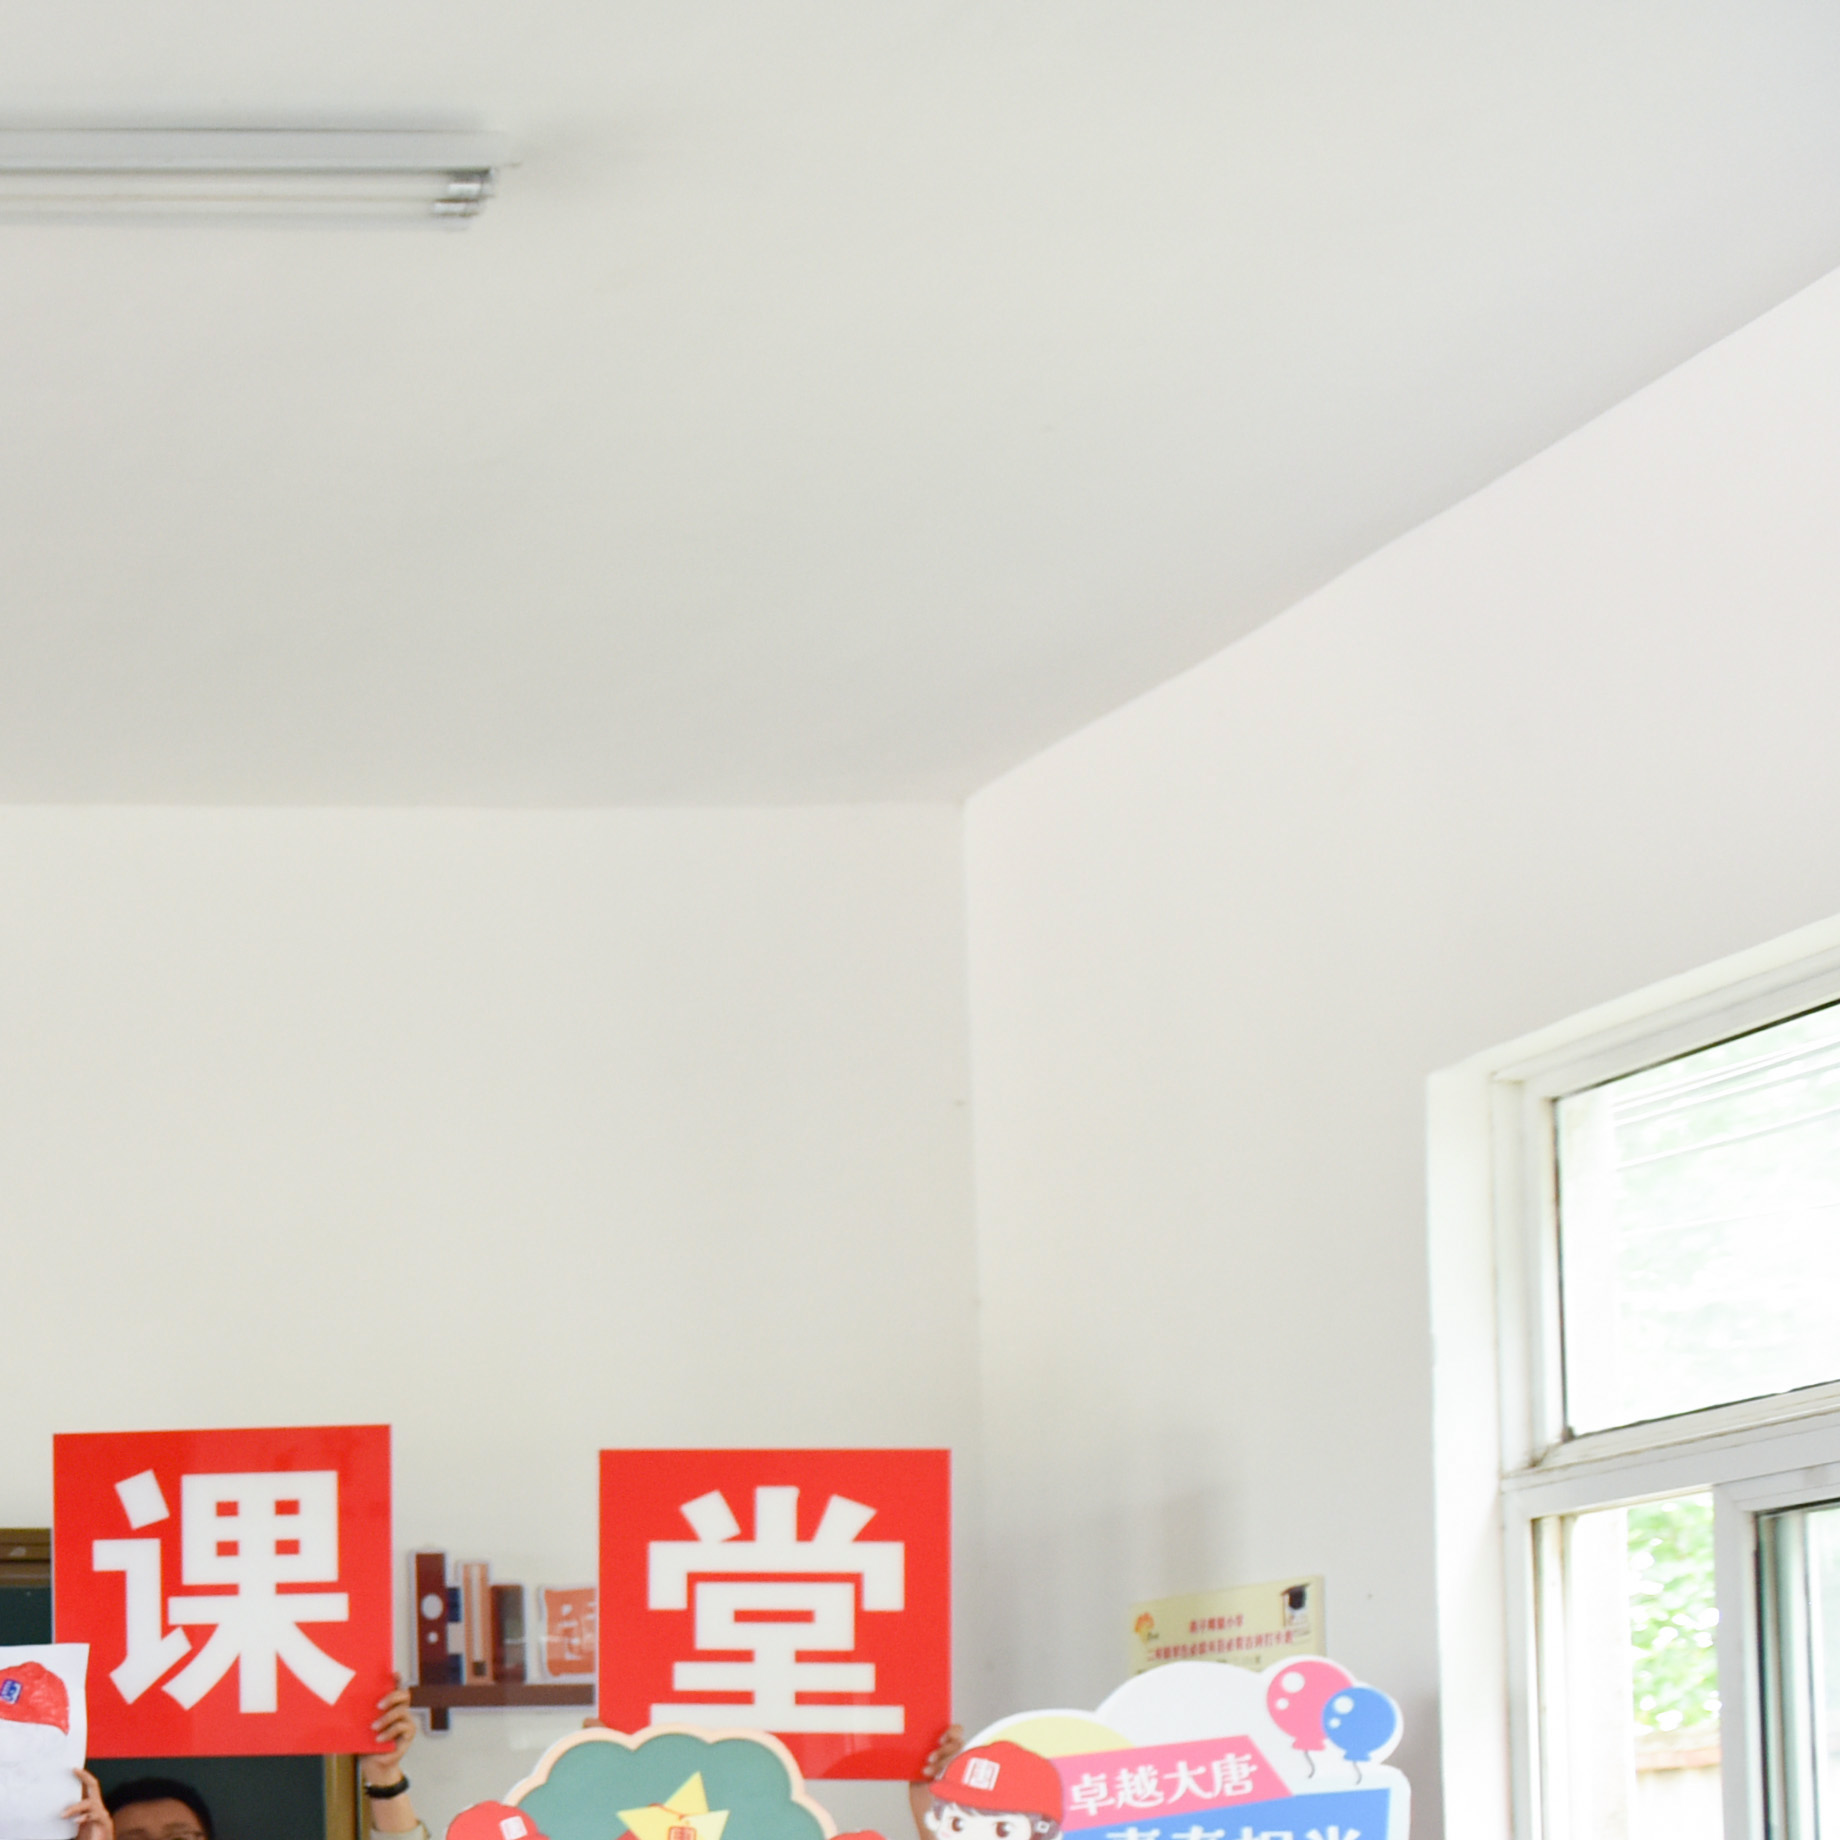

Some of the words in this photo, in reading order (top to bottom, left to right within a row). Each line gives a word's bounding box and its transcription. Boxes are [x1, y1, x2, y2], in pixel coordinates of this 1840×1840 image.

[92, 1470, 350, 1713] 课
[648, 1485, 905, 1734] 堂
[1069, 1753, 1258, 1816] 卓越大唐
